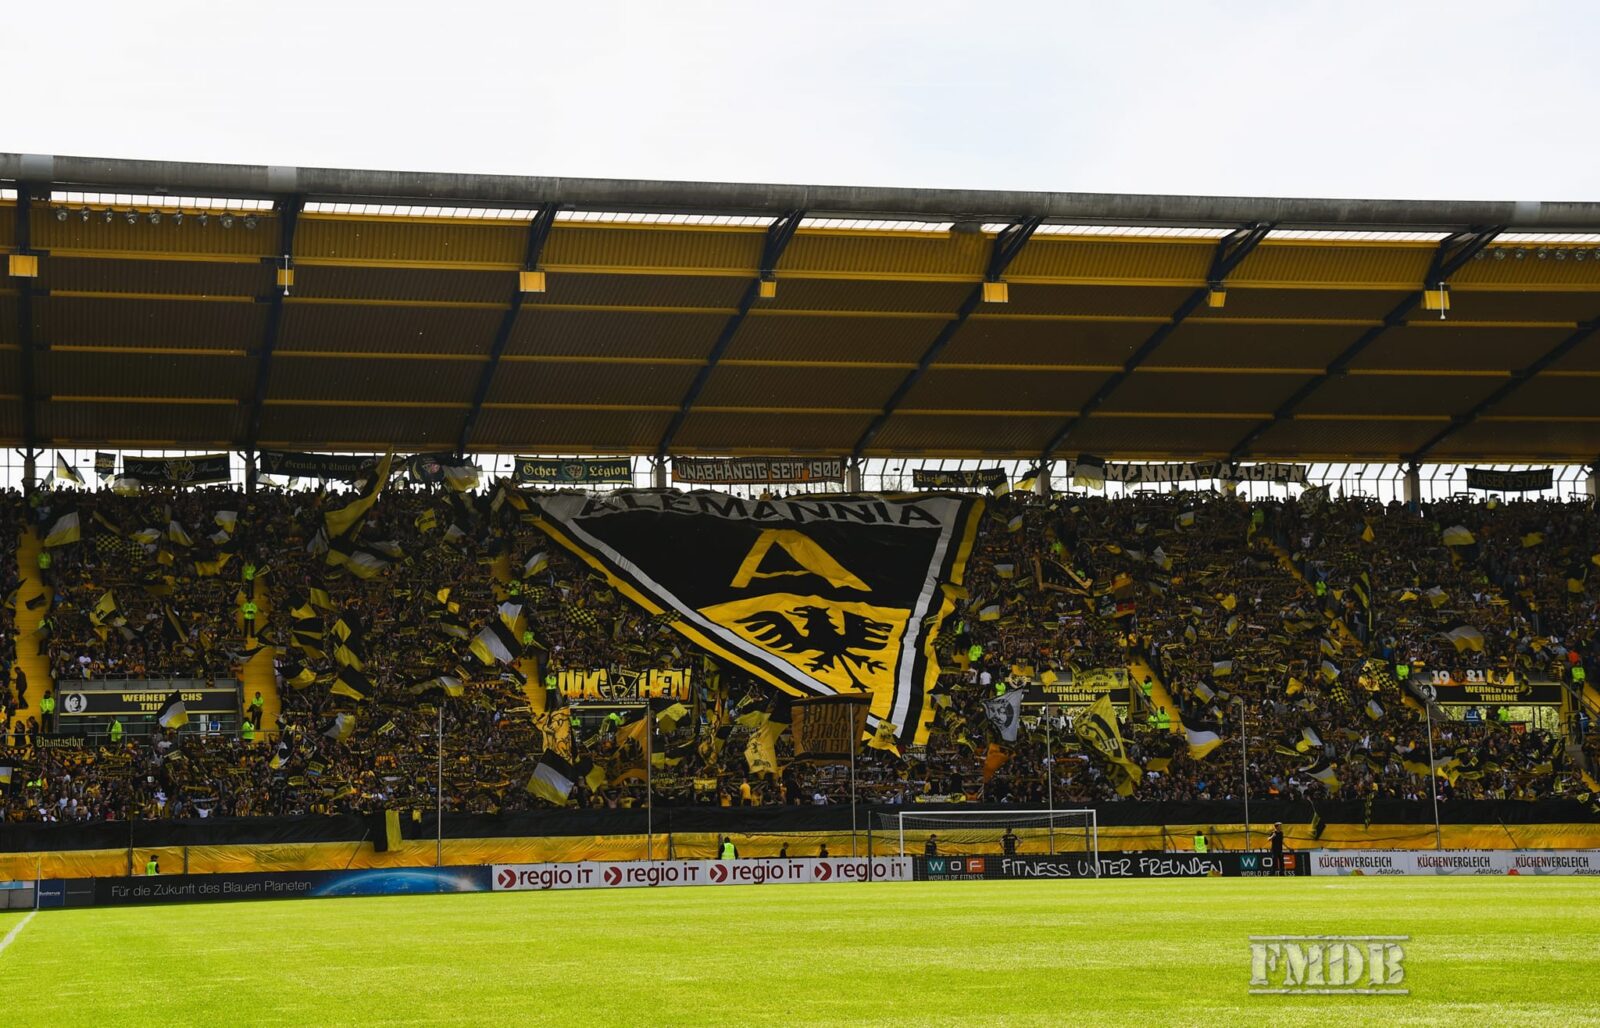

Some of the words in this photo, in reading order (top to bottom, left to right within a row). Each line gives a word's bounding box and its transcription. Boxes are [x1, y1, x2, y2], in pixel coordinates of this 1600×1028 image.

[522, 463, 558, 478] Öcher
[676, 461, 768, 481] UNABHÄNGIG
[771, 462, 804, 480] SEIT
[807, 461, 841, 479] 1900
[1217, 461, 1306, 482] AACHEN
[579, 493, 942, 526] ALEMANNIA
[121, 692, 166, 703] WERNER
[1042, 685, 1081, 694] WERNER
[1057, 692, 1097, 702] TRIBÜNE
[1464, 685, 1502, 694] WERNER
[1480, 693, 1519, 702] TRIBÜNE
[1001, 858, 1071, 877] FITNESS
[1077, 859, 1134, 877] UNTER
[1139, 857, 1224, 876] FREUNDEN
[1318, 854, 1392, 868] KÜCHENVERGLEICH
[1416, 854, 1490, 868] KÜCHENVERGLEICH
[1515, 854, 1589, 868] KÜCHENVERGLEICH
[519, 865, 573, 889] regio
[627, 862, 679, 887] regio
[732, 860, 784, 884] regio
[836, 861, 886, 883] rego
[111, 885, 130, 898] Für
[133, 885, 151, 897] die
[153, 883, 196, 897] Zukunft
[198, 882, 220, 895] des
[223, 881, 262, 894] Blauen
[264, 880, 314, 892] Planeten.
